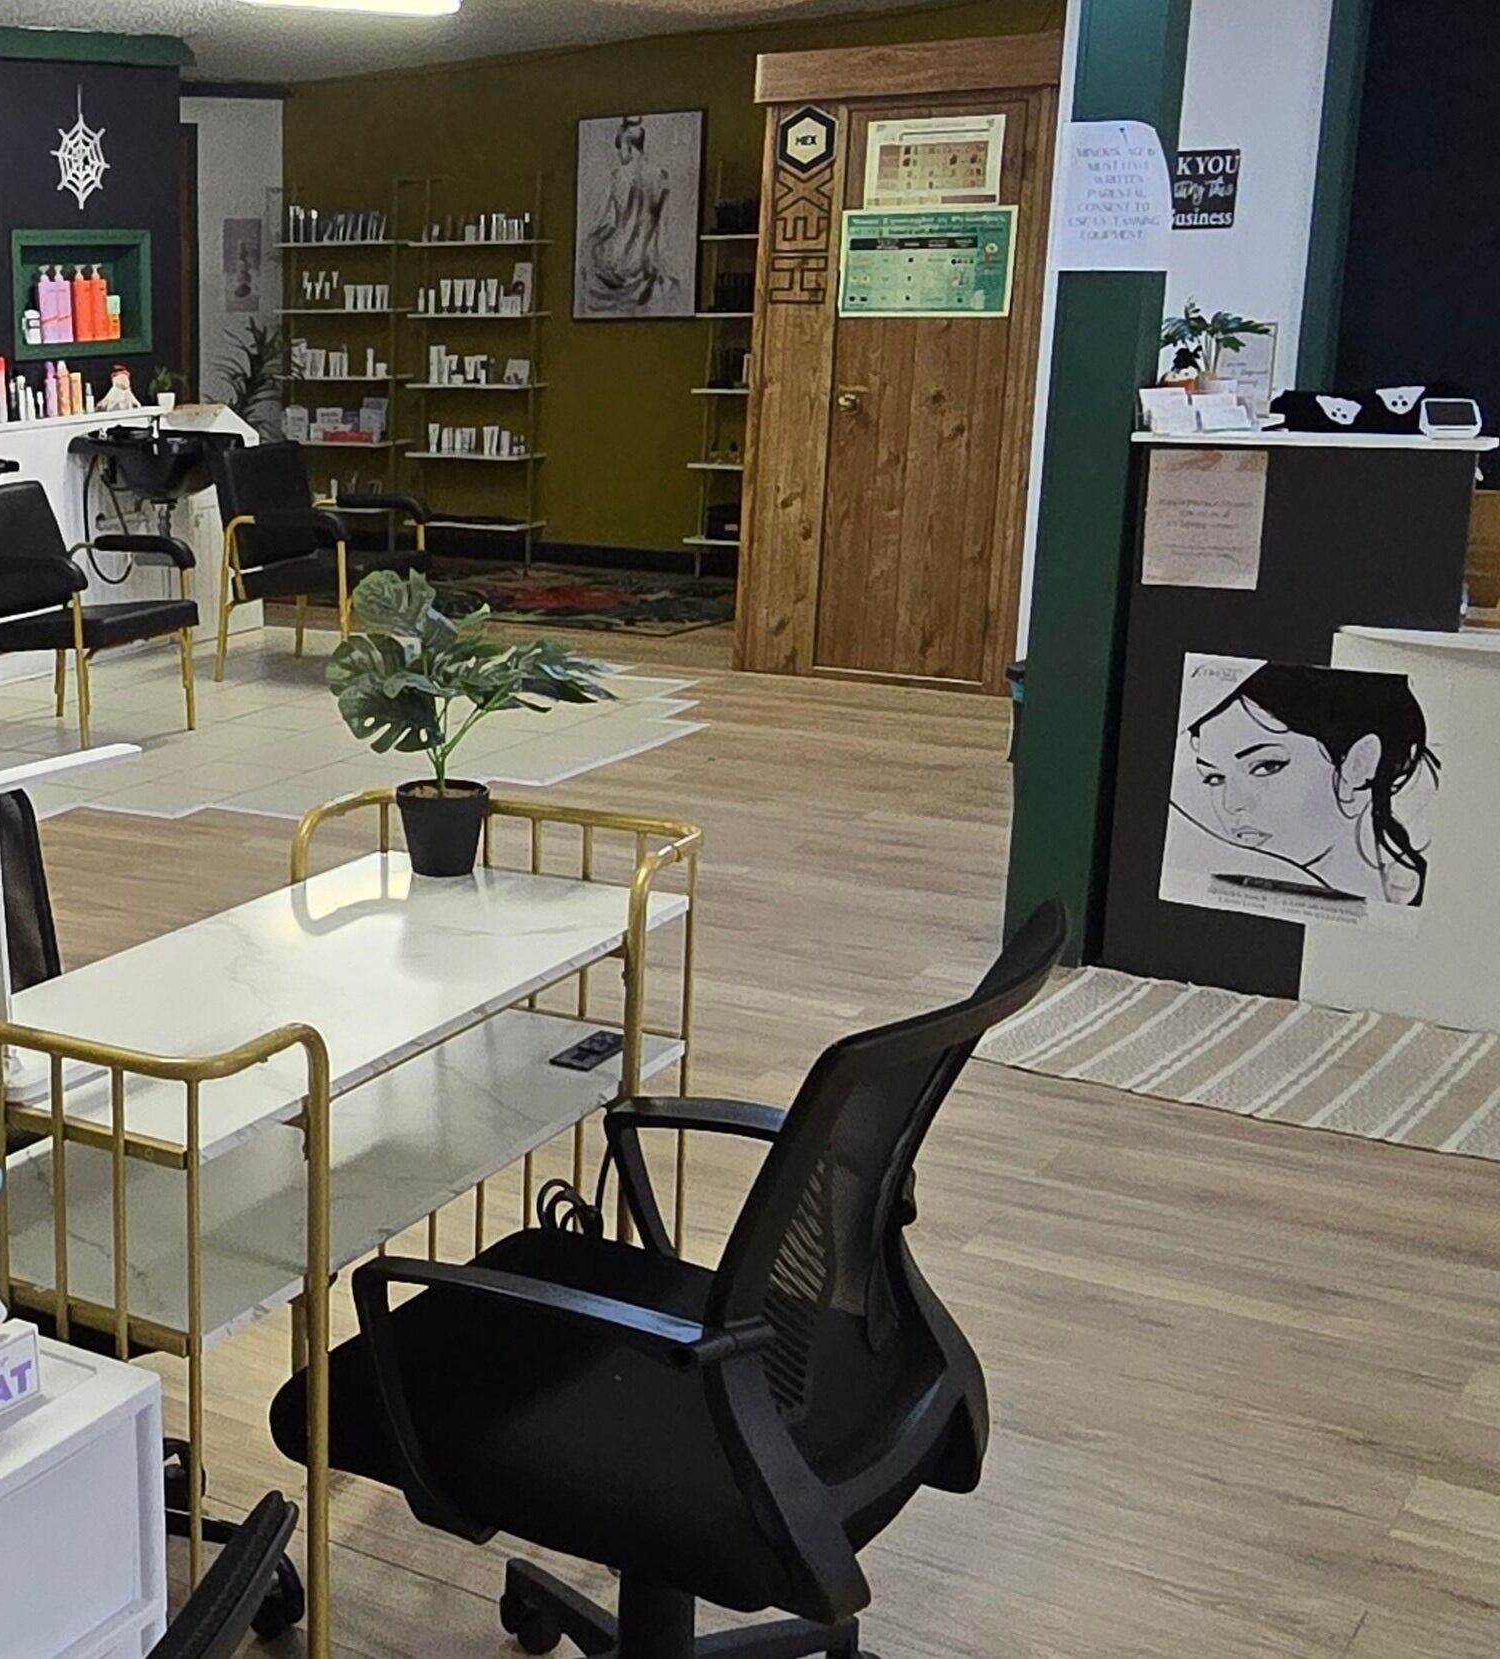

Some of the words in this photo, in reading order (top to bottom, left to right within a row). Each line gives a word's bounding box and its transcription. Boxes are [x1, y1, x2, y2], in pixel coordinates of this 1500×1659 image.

[794, 134, 818, 147] HEX
[1194, 155, 1241, 175] YOU
[768, 165, 835, 305] HEX
